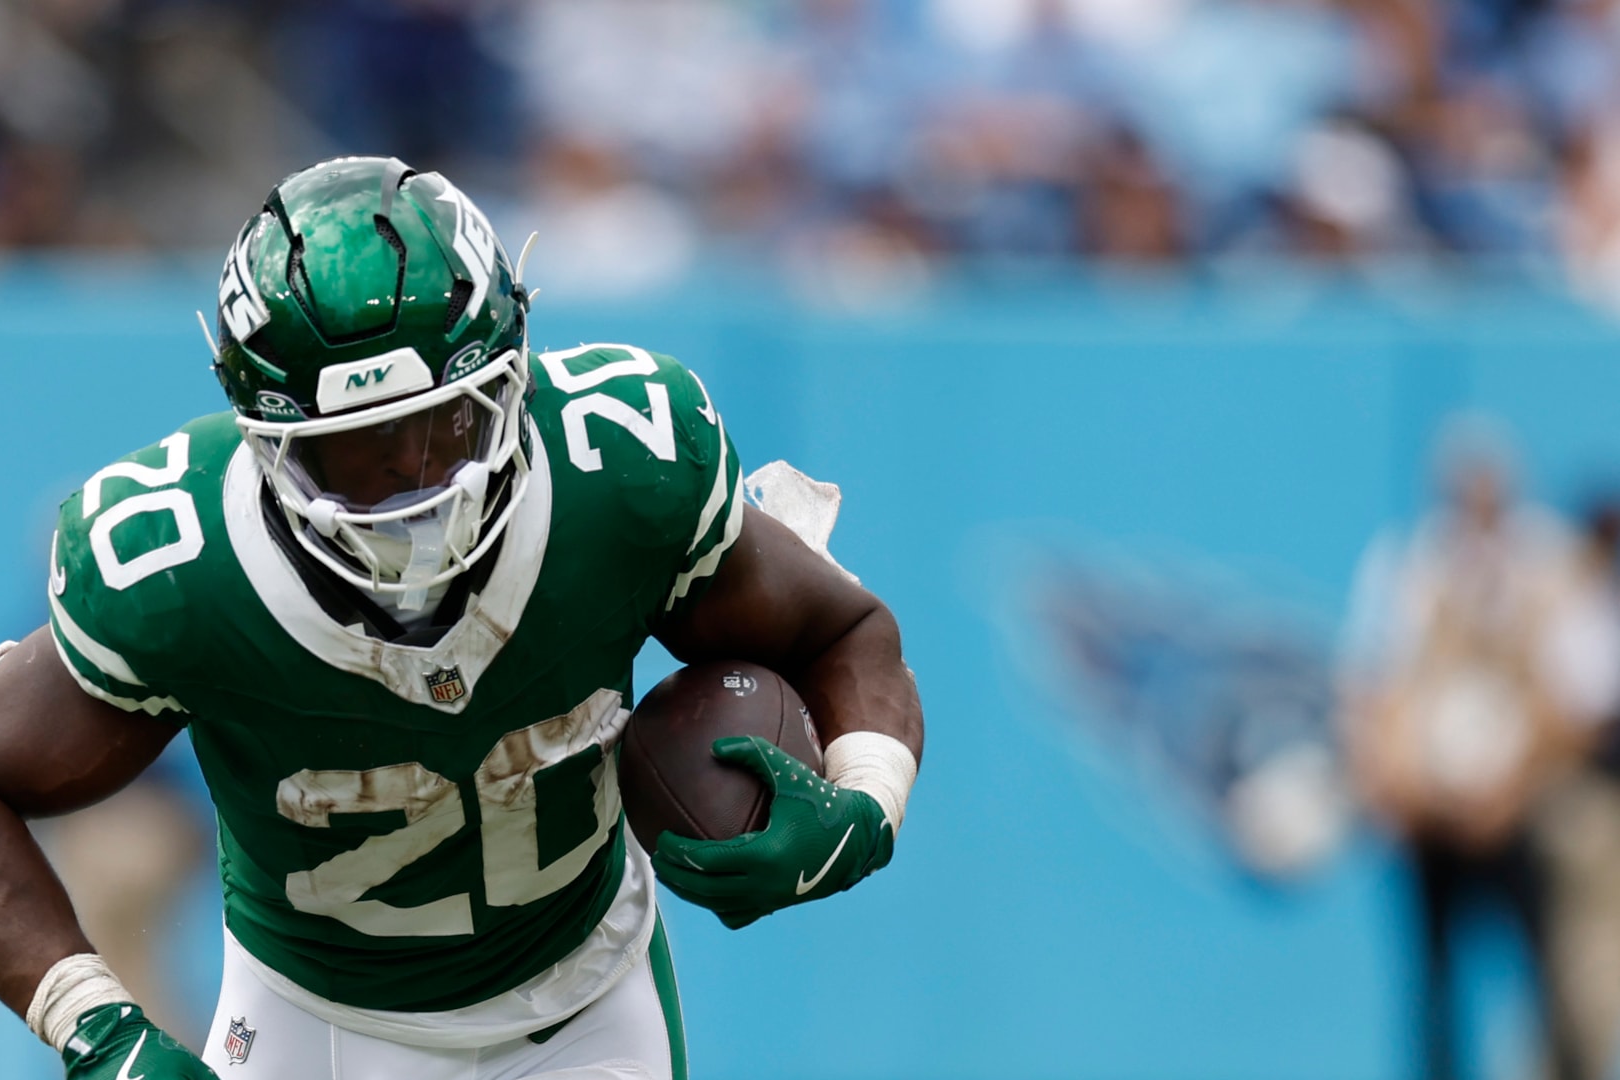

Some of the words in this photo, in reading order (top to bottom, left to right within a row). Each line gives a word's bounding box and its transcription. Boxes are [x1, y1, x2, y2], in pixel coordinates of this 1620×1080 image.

[345, 362, 395, 391] NY
[538, 342, 677, 472] 20
[80, 432, 205, 592] 20
[433, 682, 463, 700] NFL
[275, 687, 632, 938] 20
